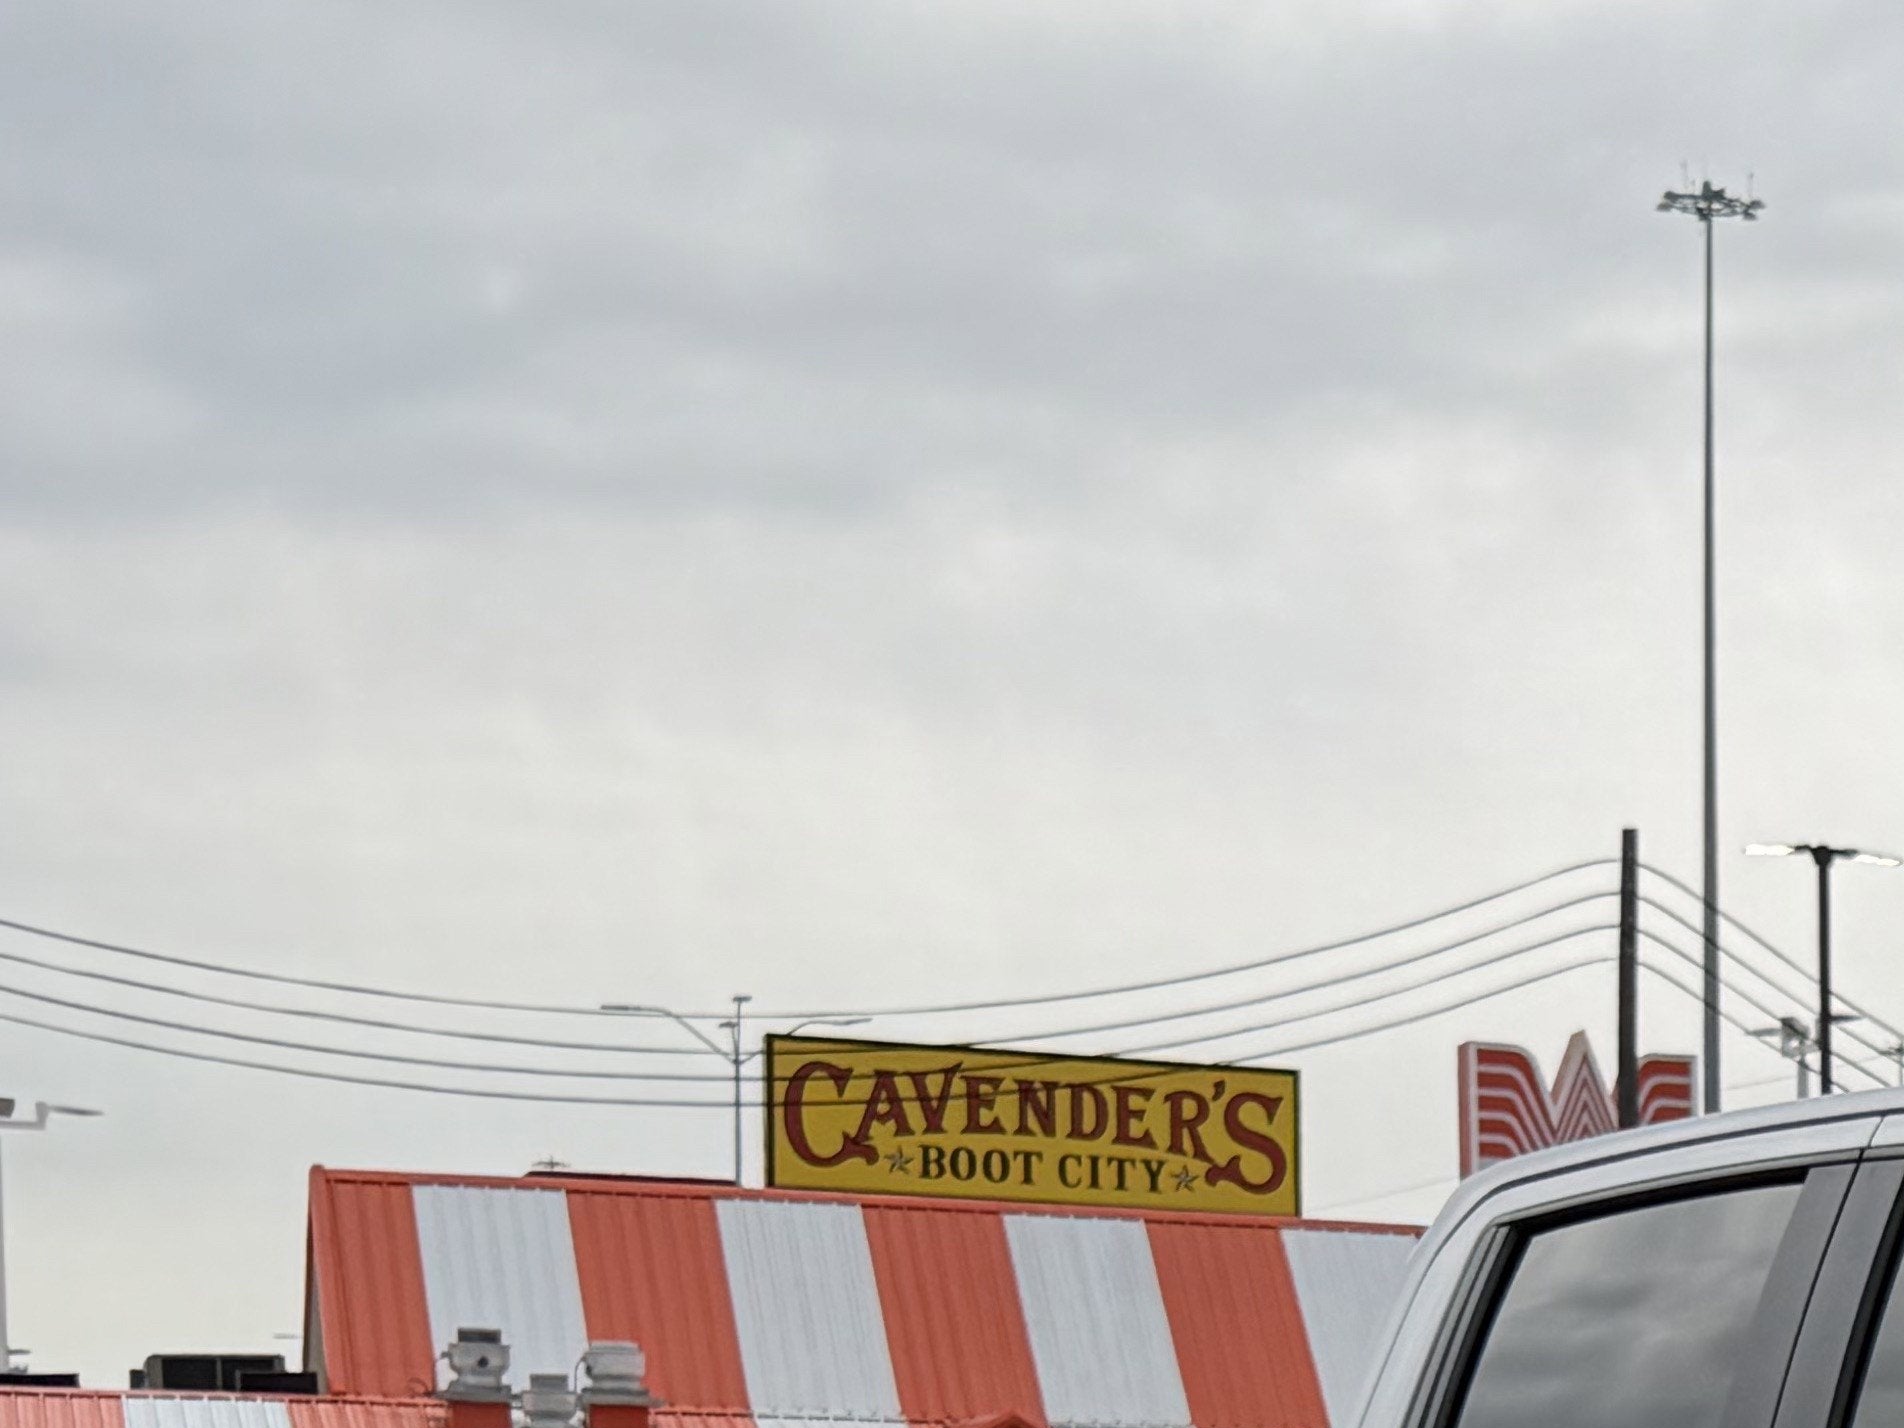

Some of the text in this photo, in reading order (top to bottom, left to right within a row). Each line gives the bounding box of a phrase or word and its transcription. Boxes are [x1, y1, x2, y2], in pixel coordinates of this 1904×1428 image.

[784, 1060, 1286, 1195] CAVENDER'S
[919, 1144, 1168, 1194] BOOT CITY
